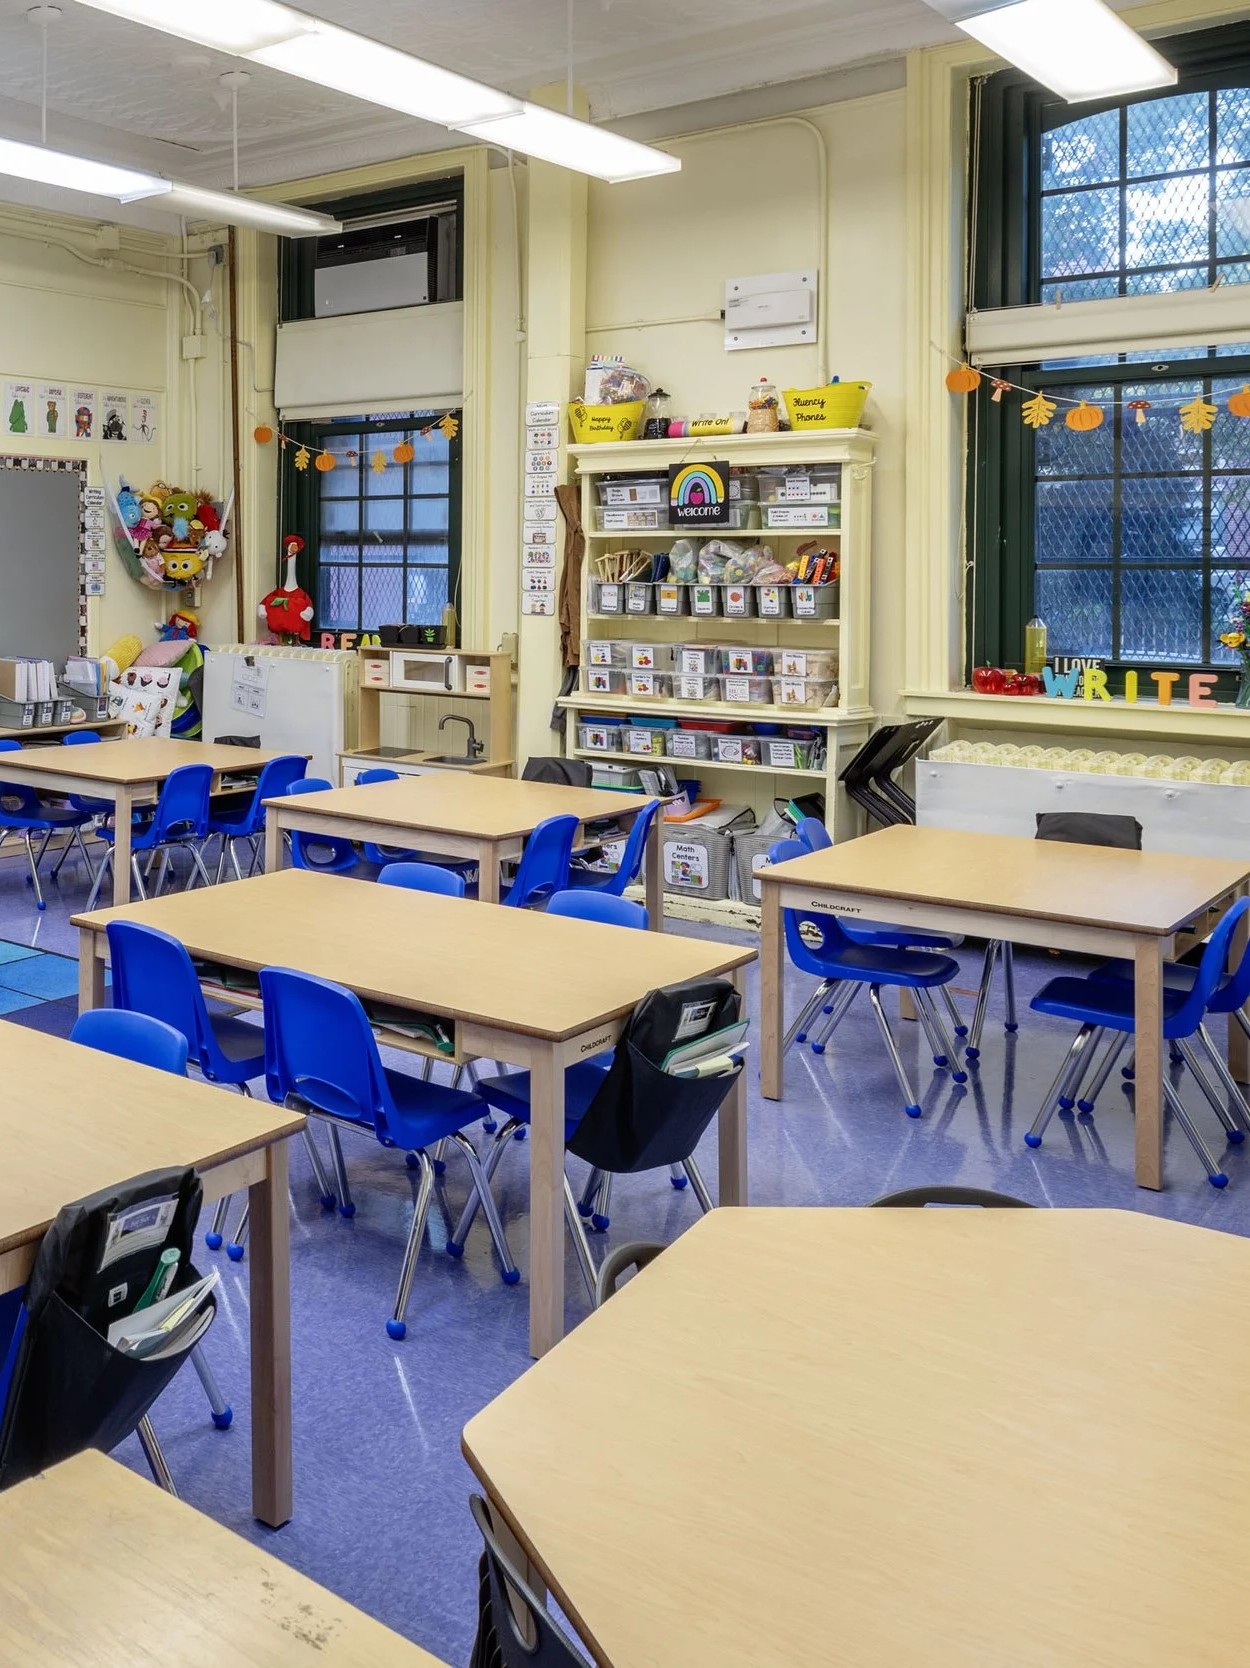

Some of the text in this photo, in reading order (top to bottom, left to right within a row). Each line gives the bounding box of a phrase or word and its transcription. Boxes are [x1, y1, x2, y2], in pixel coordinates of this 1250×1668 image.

[792, 397, 826, 409] Fluency
[590, 416, 612, 426] Happy
[796, 411, 827, 422] Phones
[691, 418, 729, 428] Write On!
[588, 425, 615, 433] Birthday
[677, 505, 721, 517] welcome
[1054, 657, 1101, 672] I LOVE
[1042, 666, 1219, 708] WRITE
[675, 843, 696, 853] Math
[671, 852, 700, 862] Centers
[810, 900, 863, 914] CHILDCRAFT
[580, 1034, 613, 1053] CHILDCRAFT
